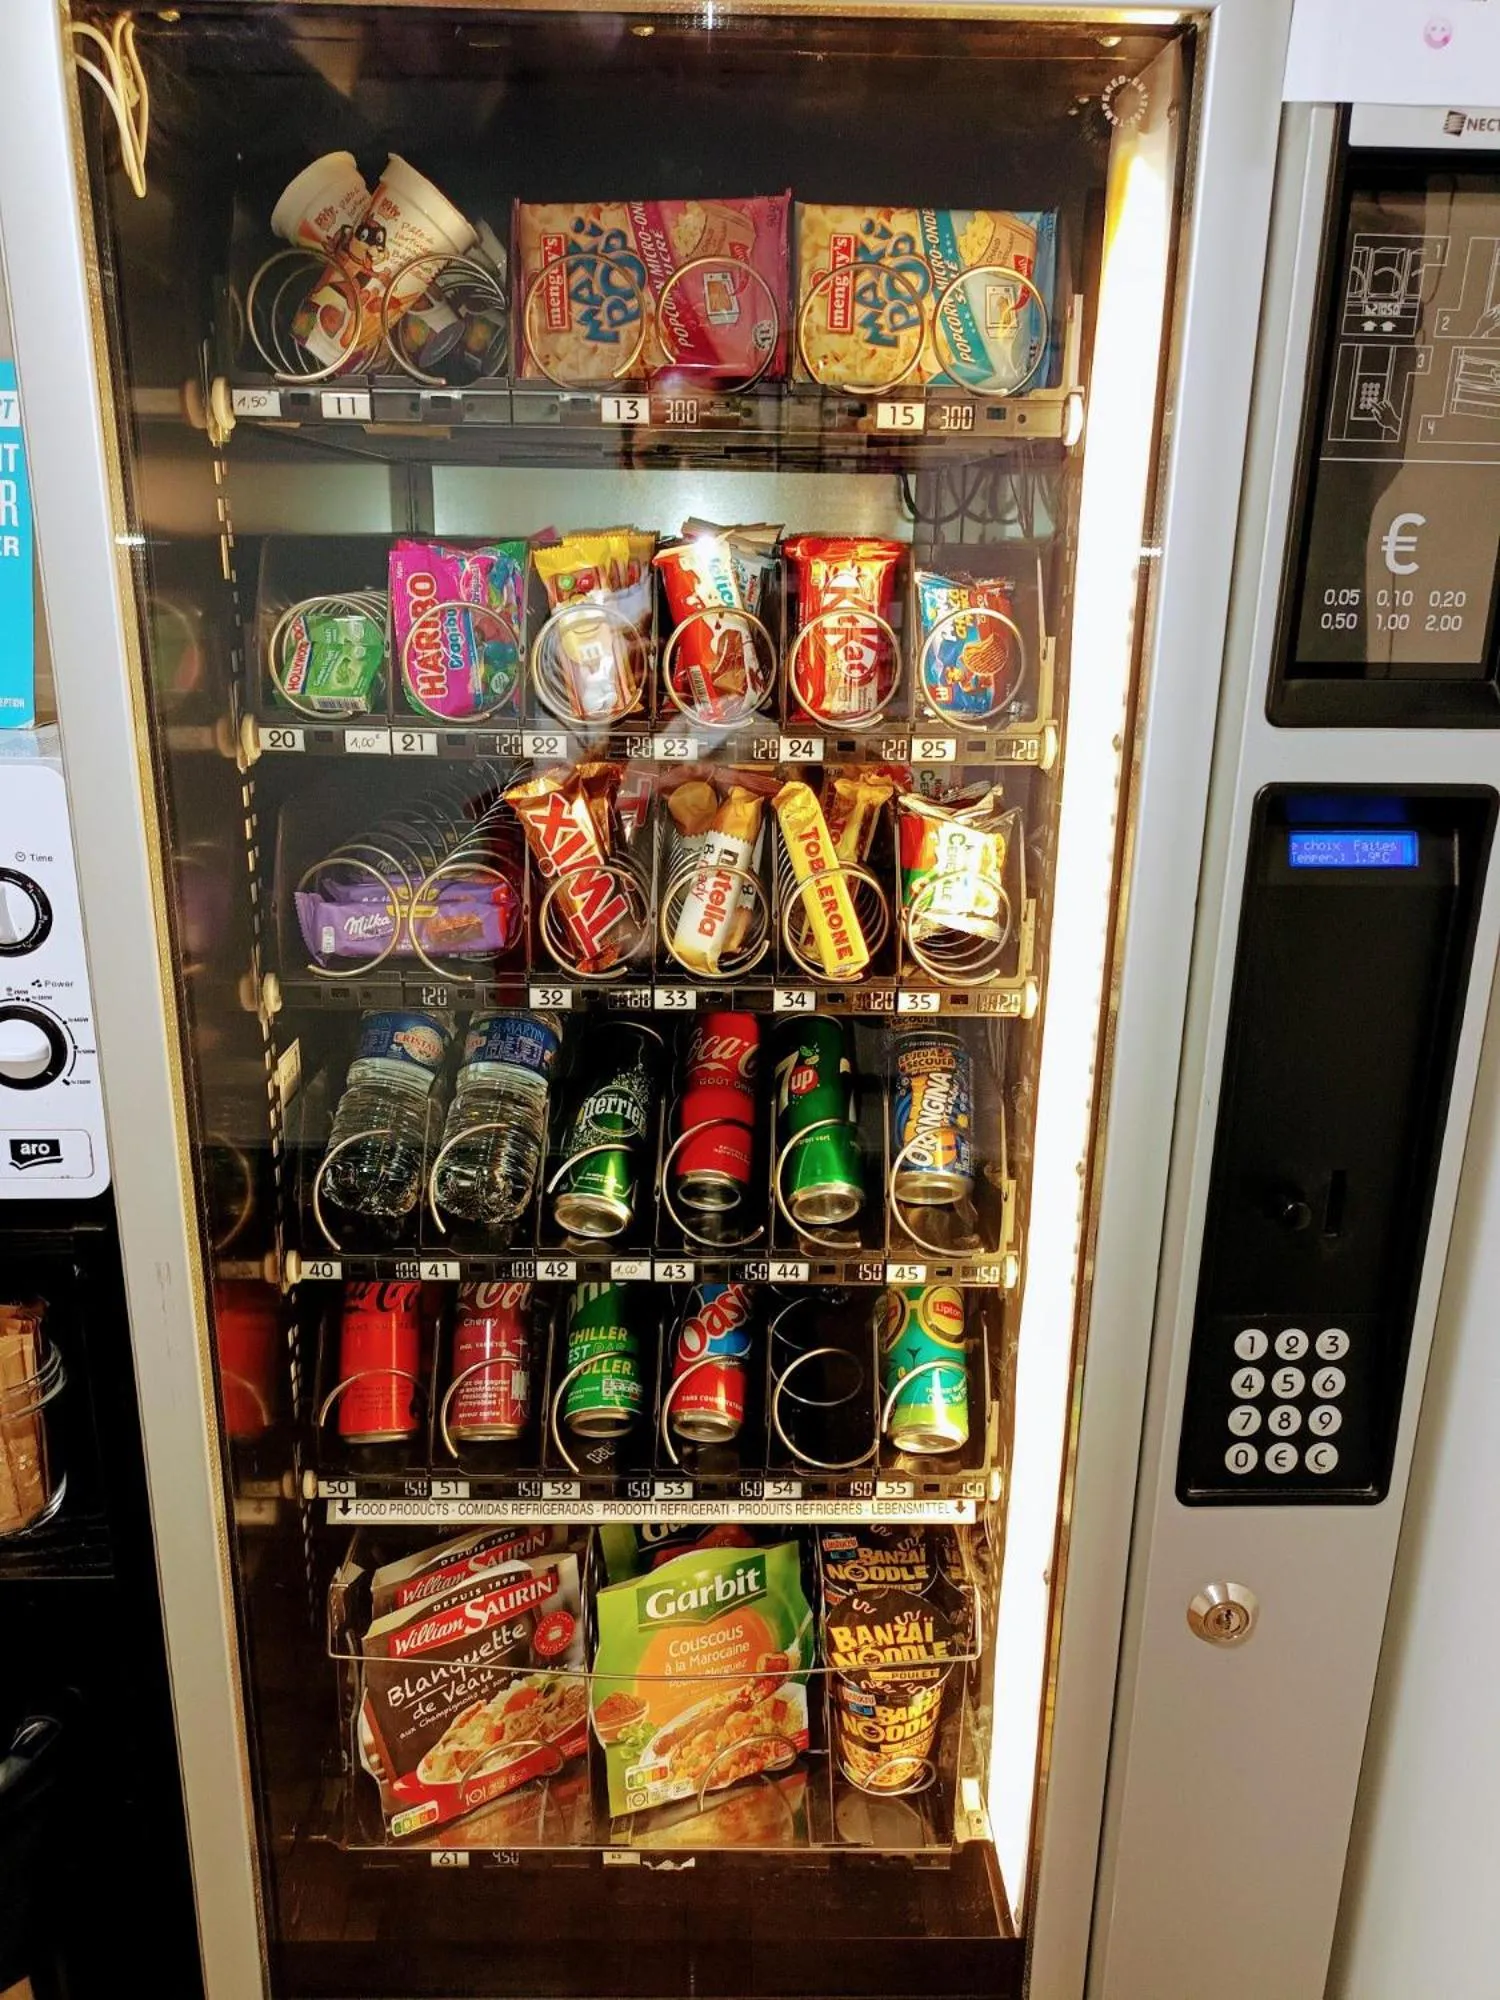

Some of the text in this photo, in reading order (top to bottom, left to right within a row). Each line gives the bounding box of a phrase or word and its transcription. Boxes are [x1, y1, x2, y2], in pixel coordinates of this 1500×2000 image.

[1434, 243, 1442, 261] 1
[597, 227, 649, 329] POP
[882, 231, 935, 332] POP
[940, 293, 977, 364] POPCORN
[1440, 316, 1451, 332] 2
[1417, 353, 1426, 369] 3
[333, 396, 357, 416] 11
[613, 399, 640, 420] 13
[889, 405, 916, 427] 15
[1426, 422, 1436, 437] 4
[1381, 512, 1426, 577] €
[407, 571, 449, 699] HARIBO
[443, 600, 466, 672] Dragibu
[268, 730, 296, 749] 20
[401, 733, 425, 752] 21
[531, 736, 559, 755] 22
[663, 739, 690, 758] 23
[788, 740, 815, 758] 24
[921, 741, 947, 759] 25
[1353, 839, 1398, 851] Faites
[29, 853, 54, 863] Time
[528, 792, 629, 960] TWIX
[697, 848, 738, 938] nutella
[797, 827, 854, 961] TOBLERONE
[343, 913, 393, 936] Milka
[44, 979, 74, 988] Power
[538, 990, 564, 1006] 32
[662, 990, 688, 1007] 33
[782, 991, 808, 1008] 34
[906, 993, 932, 1011] 35
[906, 1057, 955, 1070] SECOUER
[578, 1094, 645, 1133] perrier
[903, 1071, 954, 1168] ORANGINA
[20, 1141, 51, 1157] aro
[308, 1262, 334, 1279] 40
[427, 1263, 451, 1279] 41
[544, 1262, 570, 1278] 42
[662, 1264, 687, 1280] 43
[777, 1264, 802, 1280] 44
[894, 1265, 919, 1281] 45
[934, 1301, 963, 1319] Lipton
[462, 1317, 499, 1329] Cherry
[568, 1326, 628, 1347] CHILLER
[1247, 1335, 1340, 1355] 1 2 3
[567, 1344, 592, 1365] EST
[1240, 1373, 1336, 1393] 4 5 6
[1239, 1411, 1333, 1430] 7 8 9
[1234, 1449, 1328, 1468] 0 C
[326, 1480, 350, 1495] 50
[439, 1481, 461, 1495] 51
[550, 1482, 573, 1495] 52
[663, 1482, 686, 1495] 53
[771, 1481, 794, 1495] 54
[884, 1481, 907, 1495] 55
[355, 1501, 952, 1517] FOOD PRODUCTS COMIDAS REFRIGERADAS PRODOTTI REFRIGERATI PRODUITS REFRIGÉRÉS LEBENSMITTEL
[439, 1541, 487, 1567] DEPUIS
[856, 1543, 927, 1566] BANZAÏ
[401, 1532, 547, 1606] William SAURIN
[826, 1565, 930, 1583] NOODLE
[432, 1587, 483, 1613] DEPUIS
[644, 1566, 761, 1619] Garbit
[393, 1616, 465, 1657] William
[464, 1577, 554, 1635] SAURIN
[668, 1623, 744, 1659] Couscous
[829, 1615, 935, 1654] BANZAÏ
[386, 1623, 528, 1708] Blanquette
[664, 1640, 752, 1675] à la Marocaine
[831, 1641, 950, 1671] NOODLE
[412, 1671, 496, 1722] de Veau
[398, 1725, 418, 1741] aux
[418, 1690, 482, 1729] Champignons
[438, 1852, 459, 1866] 61
